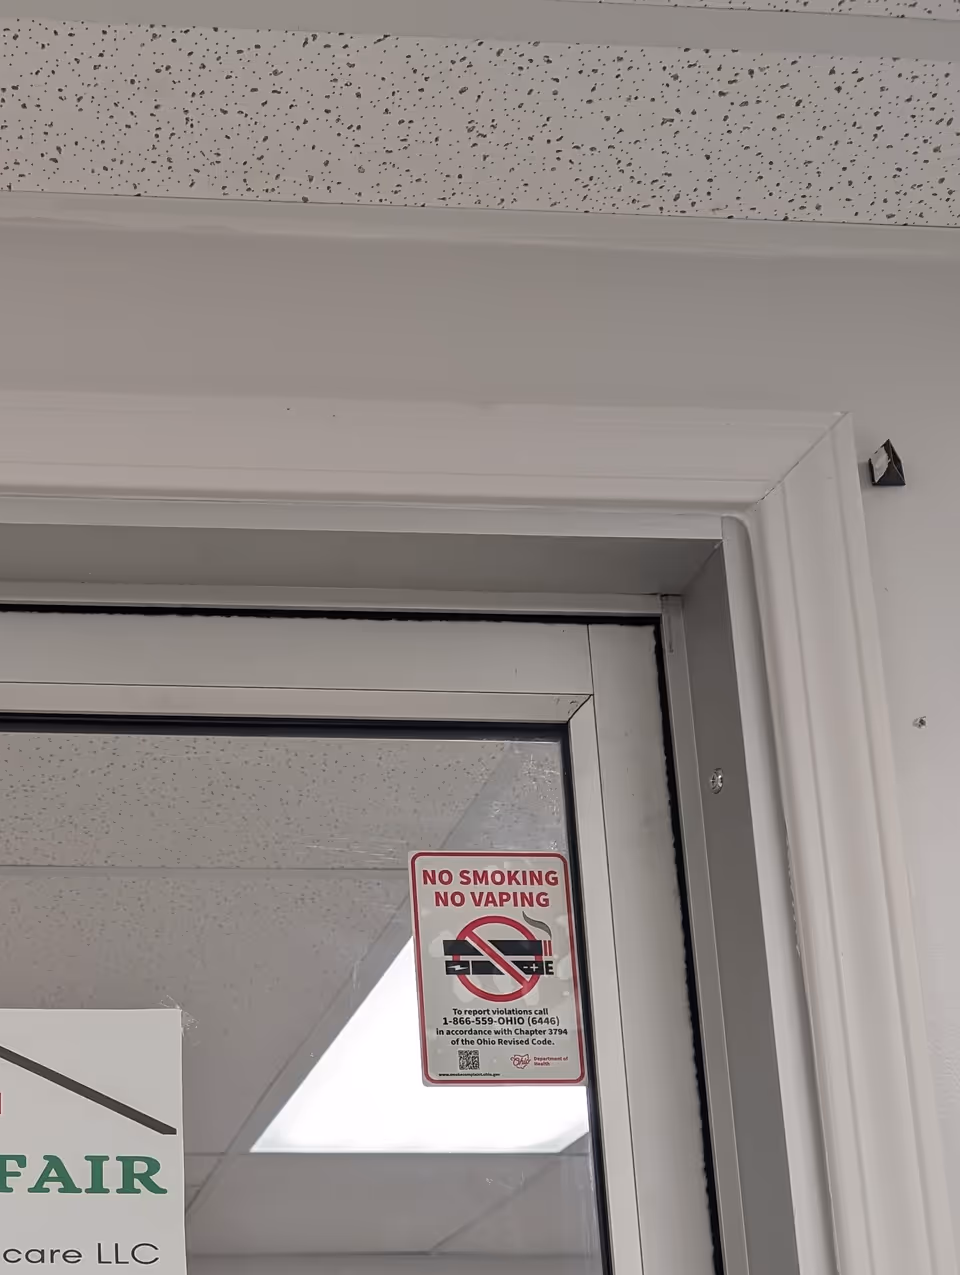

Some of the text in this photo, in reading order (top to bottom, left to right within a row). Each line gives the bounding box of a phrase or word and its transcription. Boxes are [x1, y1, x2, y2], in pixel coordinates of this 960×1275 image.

[423, 870, 559, 886] NO SMOKING
[435, 892, 549, 907] NO VAPING
[443, 1017, 559, 1026] 1-866-559-OHIO (6446)
[97, 1242, 160, 1265] LLC
